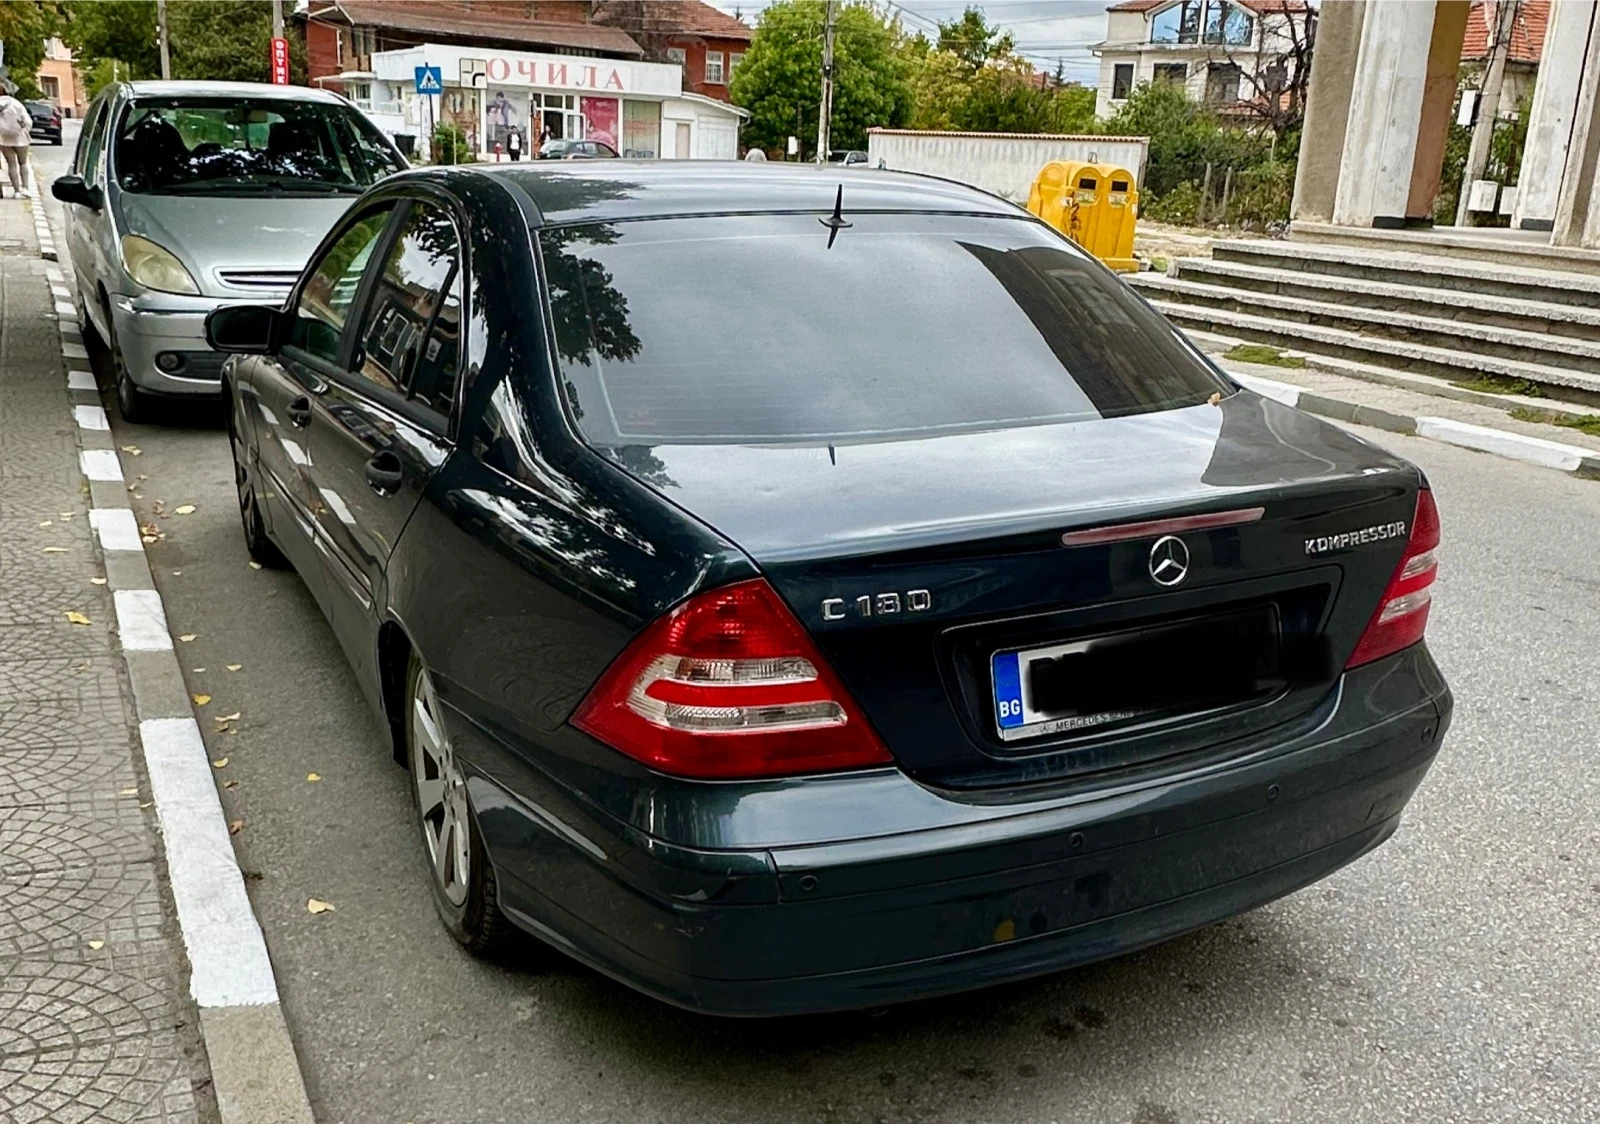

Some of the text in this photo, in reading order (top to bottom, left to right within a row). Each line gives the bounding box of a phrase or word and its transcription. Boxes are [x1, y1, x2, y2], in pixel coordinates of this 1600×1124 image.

[486, 57, 625, 90] ОЧИЛА
[1304, 520, 1406, 554] KOMPRESSOR
[821, 588, 932, 621] C 180
[999, 699, 1021, 718] BG
